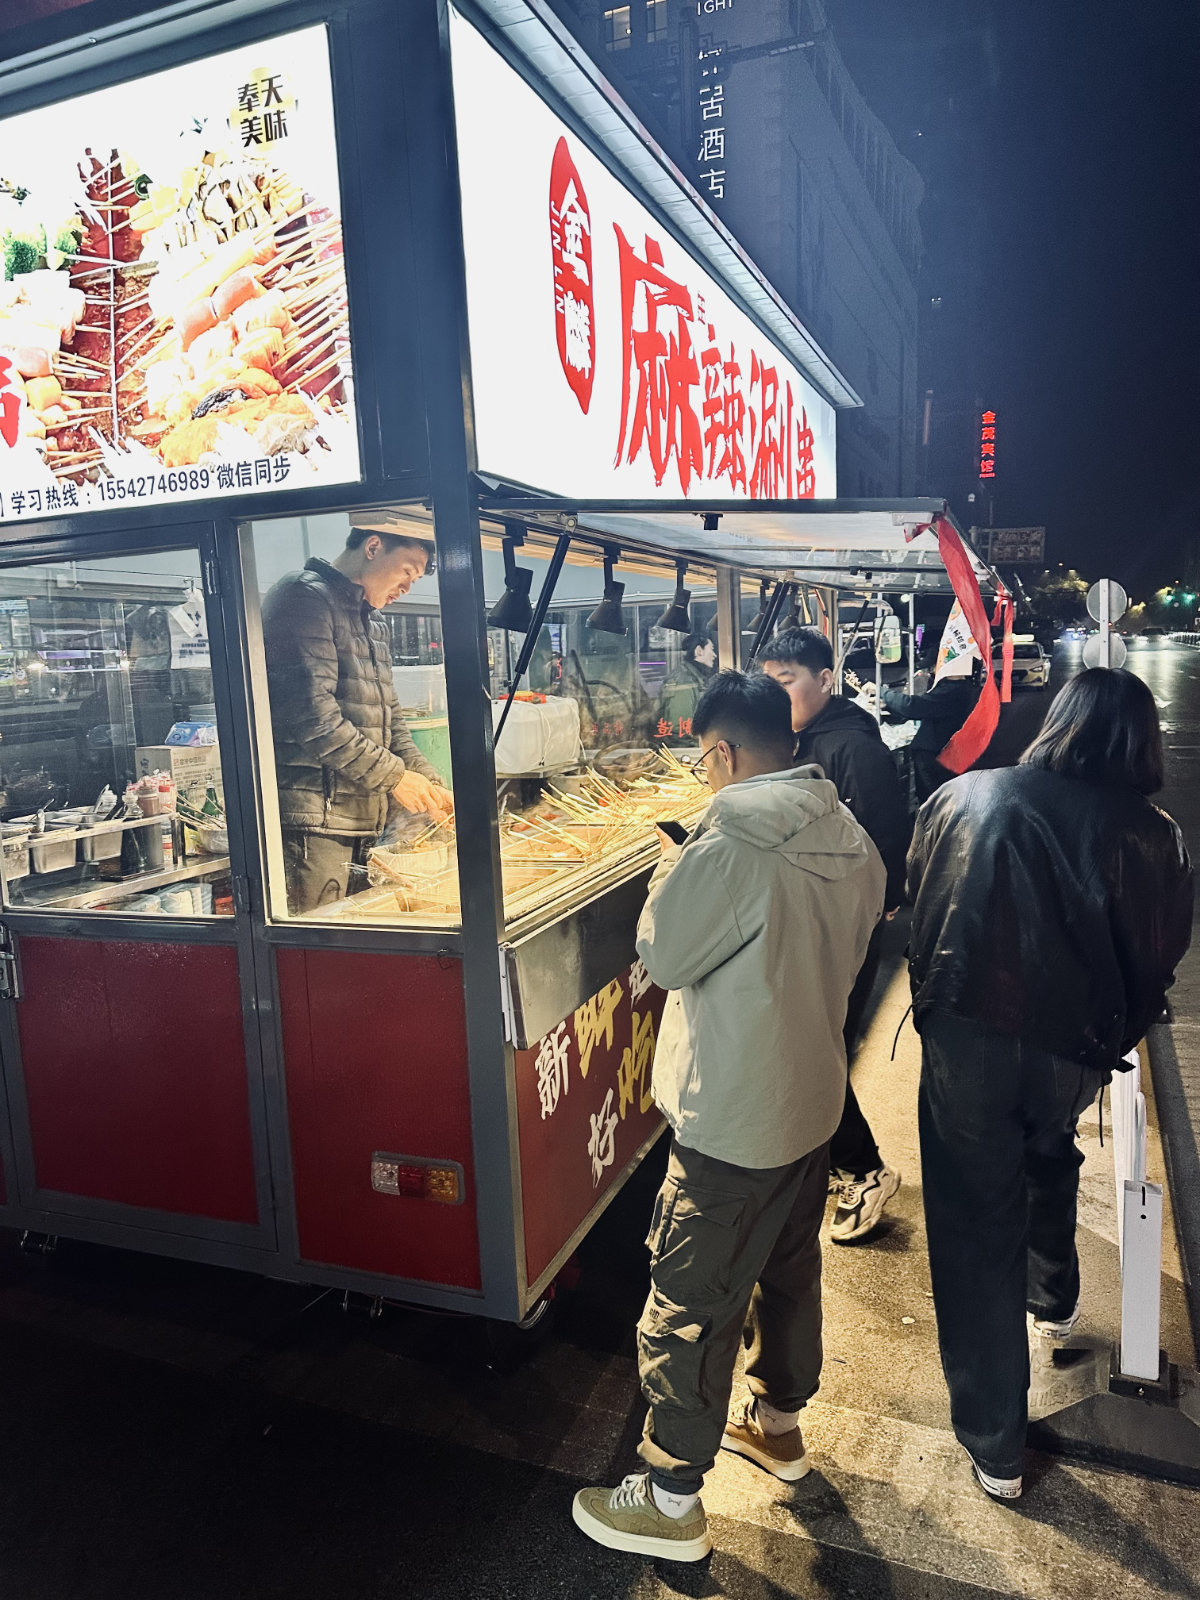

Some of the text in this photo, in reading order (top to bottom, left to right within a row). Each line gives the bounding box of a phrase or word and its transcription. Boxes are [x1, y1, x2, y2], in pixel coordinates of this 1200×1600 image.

[238, 74, 283, 112] 奉天
[240, 109, 288, 148] 美味
[551, 201, 565, 315] JIN LIN
[216, 455, 291, 490] 微信同步
